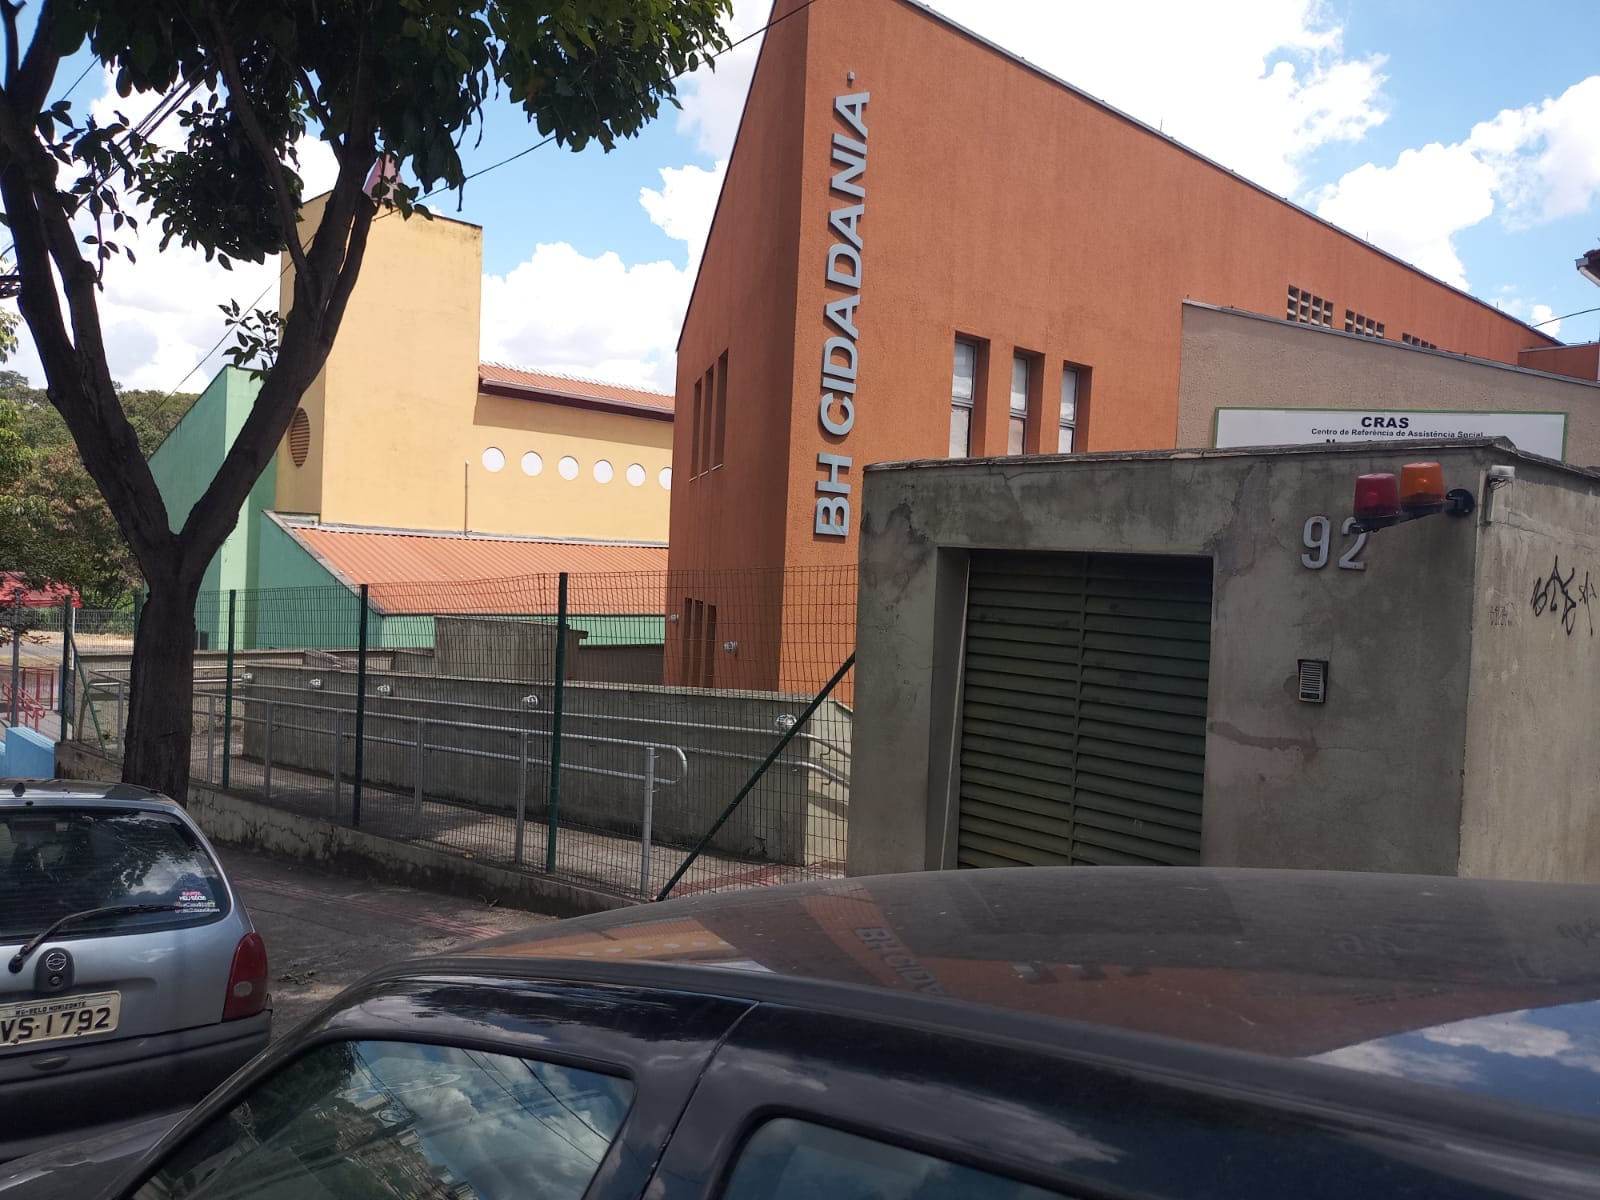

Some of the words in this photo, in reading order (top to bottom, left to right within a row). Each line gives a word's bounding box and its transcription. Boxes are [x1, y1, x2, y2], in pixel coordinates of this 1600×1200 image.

[820, 91, 870, 436] CIDADANIA
[1311, 428, 1338, 436] Centro
[1339, 428, 1349, 436] de
[1351, 429, 1394, 437] Referência
[1408, 430, 1455, 438] Assistência
[1457, 431, 1484, 439] Social
[1361, 416, 1409, 429] CRAS
[815, 453, 853, 537] BH
[1301, 515, 1370, 572] 92
